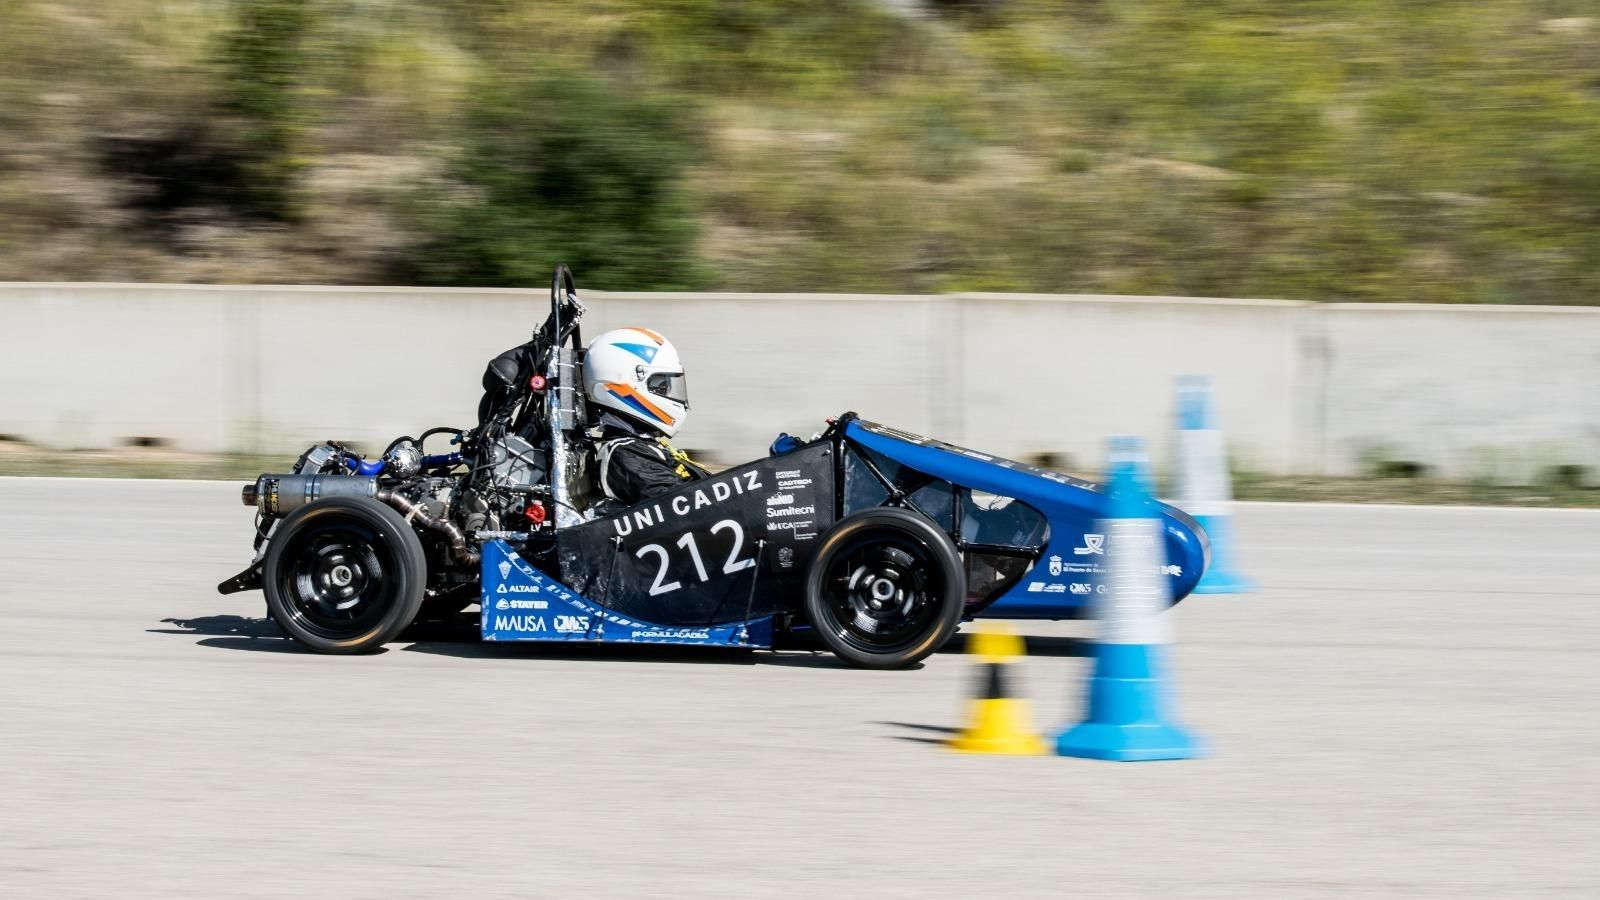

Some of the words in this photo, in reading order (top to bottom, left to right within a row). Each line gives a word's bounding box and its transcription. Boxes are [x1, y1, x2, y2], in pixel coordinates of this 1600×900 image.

[613, 504, 665, 537] UNI
[671, 470, 763, 516] CADIZ
[766, 504, 815, 518] Sumitecni
[530, 523, 542, 532] LV
[635, 519, 757, 597] 212
[508, 585, 540, 593] ALTAIR
[509, 600, 549, 609] STAYER
[494, 615, 547, 632] MAUSA
